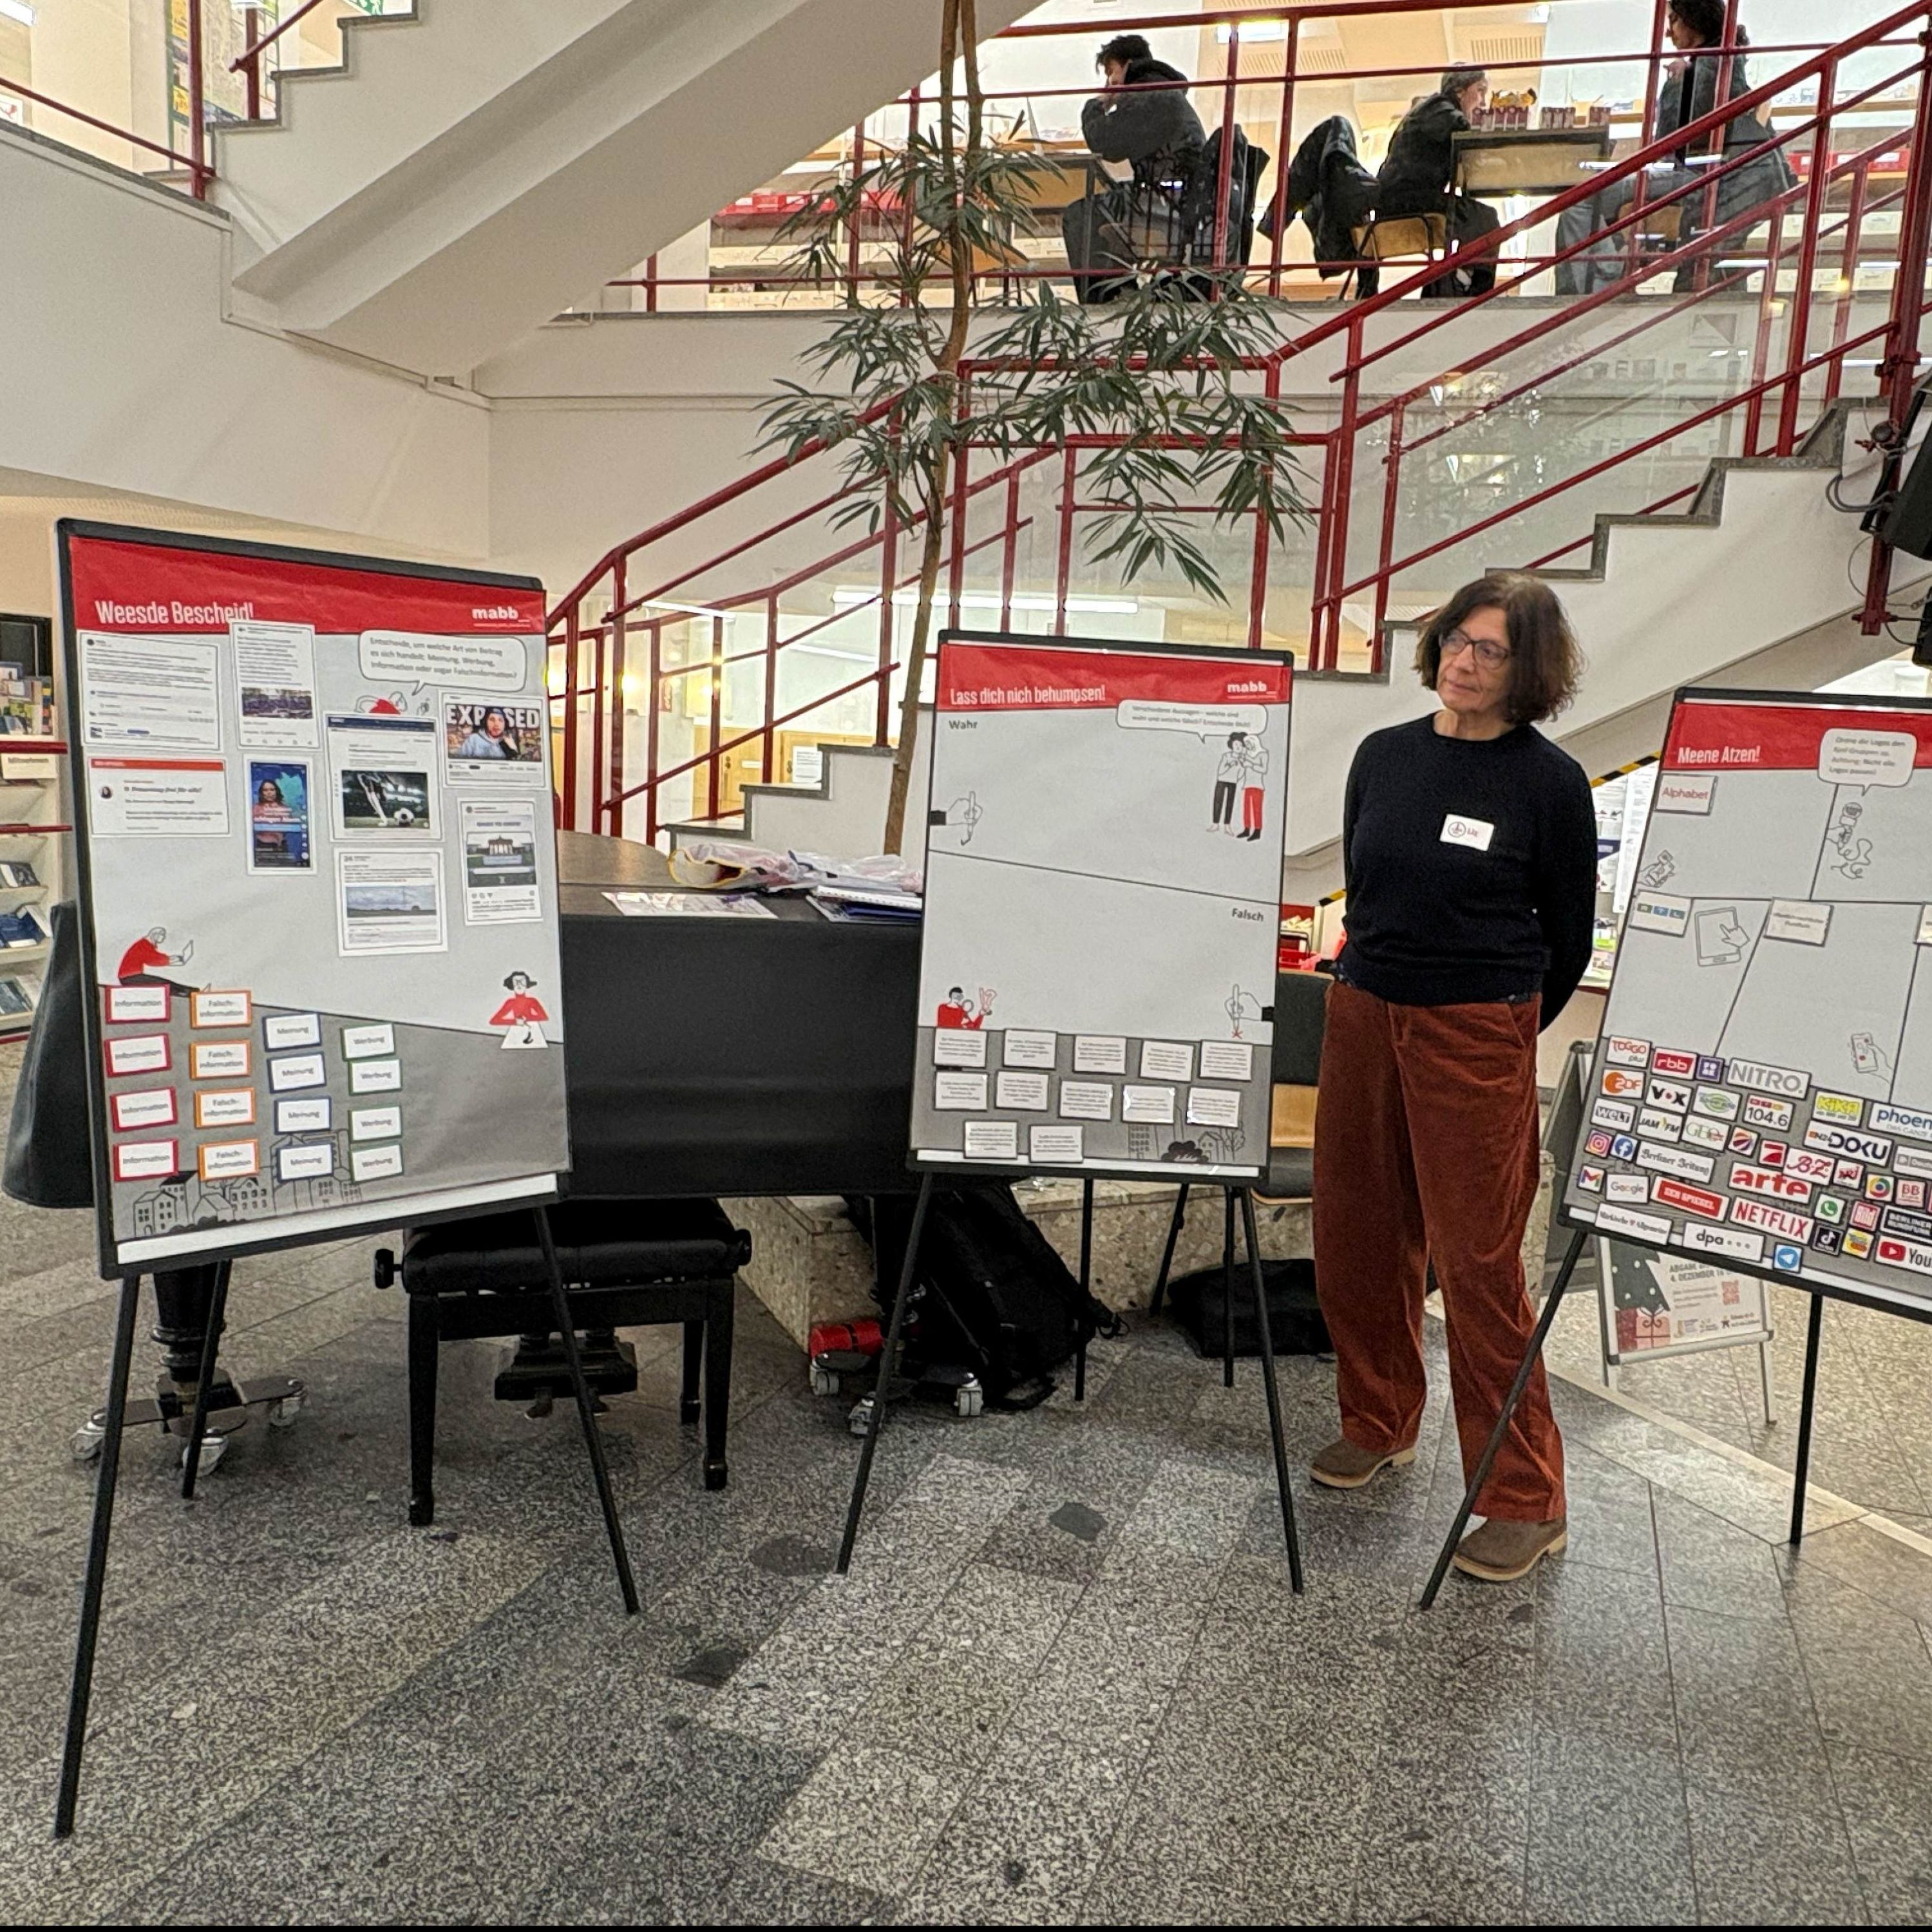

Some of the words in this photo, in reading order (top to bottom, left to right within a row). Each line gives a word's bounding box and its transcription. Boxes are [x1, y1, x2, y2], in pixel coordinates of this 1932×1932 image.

[95, 601, 169, 624] Weesde
[171, 601, 254, 624] Bescheid!
[472, 607, 518, 620] mabb
[950, 688, 978, 705] Lass
[980, 687, 1005, 704] dich
[1007, 686, 1032, 703] nich
[1035, 684, 1106, 704] behumpsen!
[1227, 681, 1267, 692] mabb
[447, 705, 540, 728] EXPSED
[949, 721, 978, 730] Wahr
[1678, 747, 1719, 764] Meene
[1721, 745, 1760, 763] Atzen!
[1662, 786, 1709, 800] Alphabet
[1232, 908, 1264, 922] Falsch
[1612, 1039, 1647, 1054] TOGGO
[1657, 1056, 1688, 1070] rbb
[1652, 1085, 1687, 1106] VOX
[1747, 1106, 1789, 1126] 104.6
[1610, 1181, 1644, 1196] Google
[1732, 1169, 1808, 1196] arte
[1735, 1201, 1809, 1240] NETFLIX
[1696, 1229, 1724, 1247] dpa
